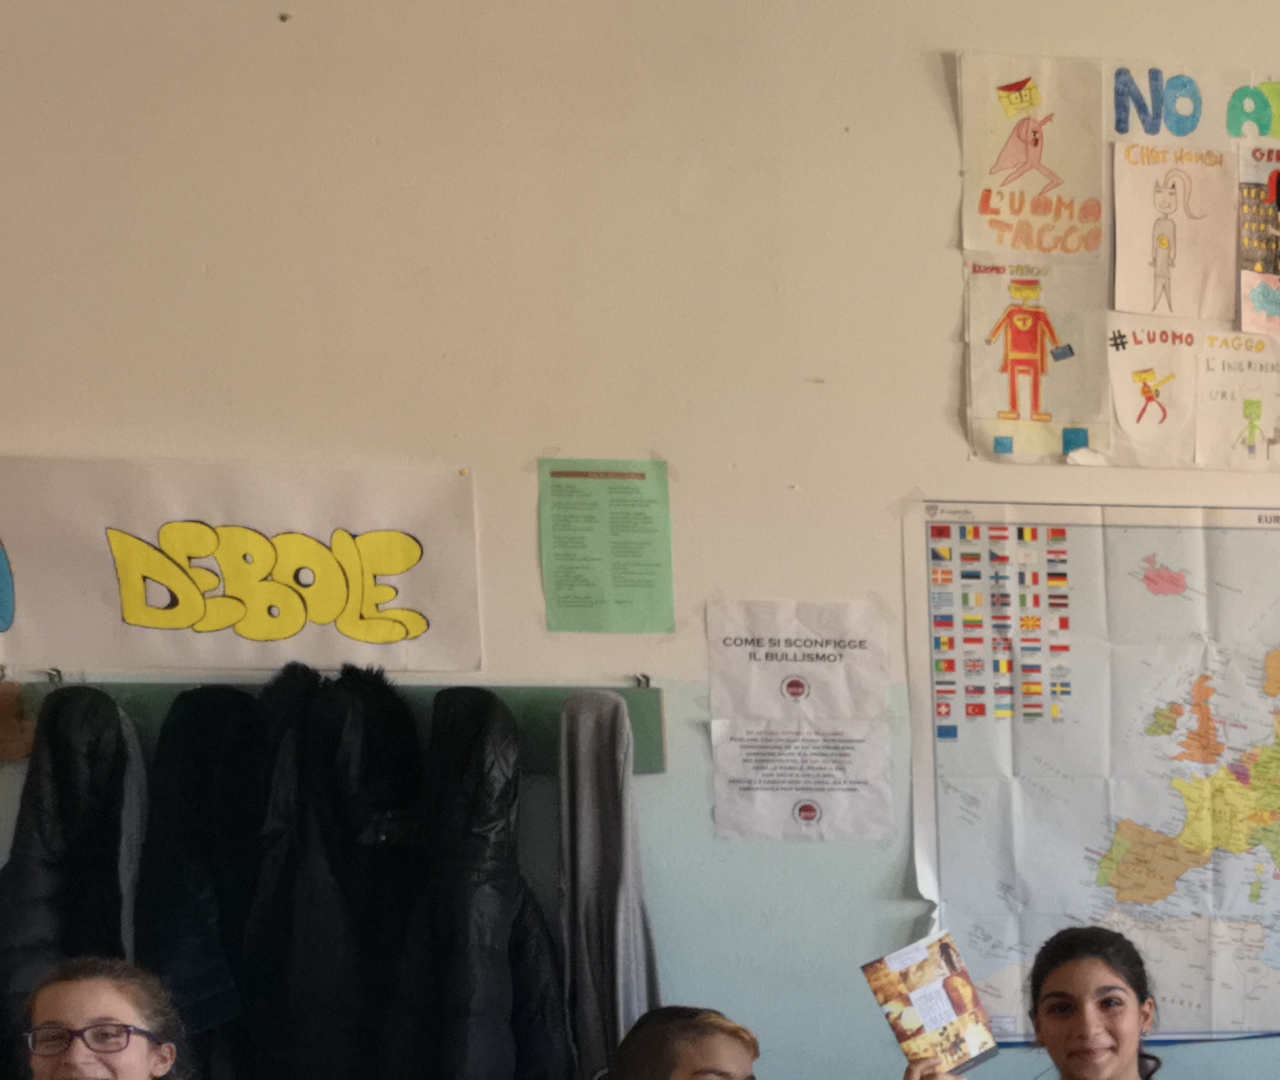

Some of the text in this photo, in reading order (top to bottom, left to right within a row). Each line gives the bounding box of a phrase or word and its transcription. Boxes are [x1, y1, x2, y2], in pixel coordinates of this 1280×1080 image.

[1114, 68, 1202, 137] NO
[1207, 336, 1266, 353] TAGGO
[105, 519, 431, 645] DEBOLE
[722, 637, 868, 650] COME SI SCONFIGGE
[749, 652, 844, 663] IL BULLISMO?
